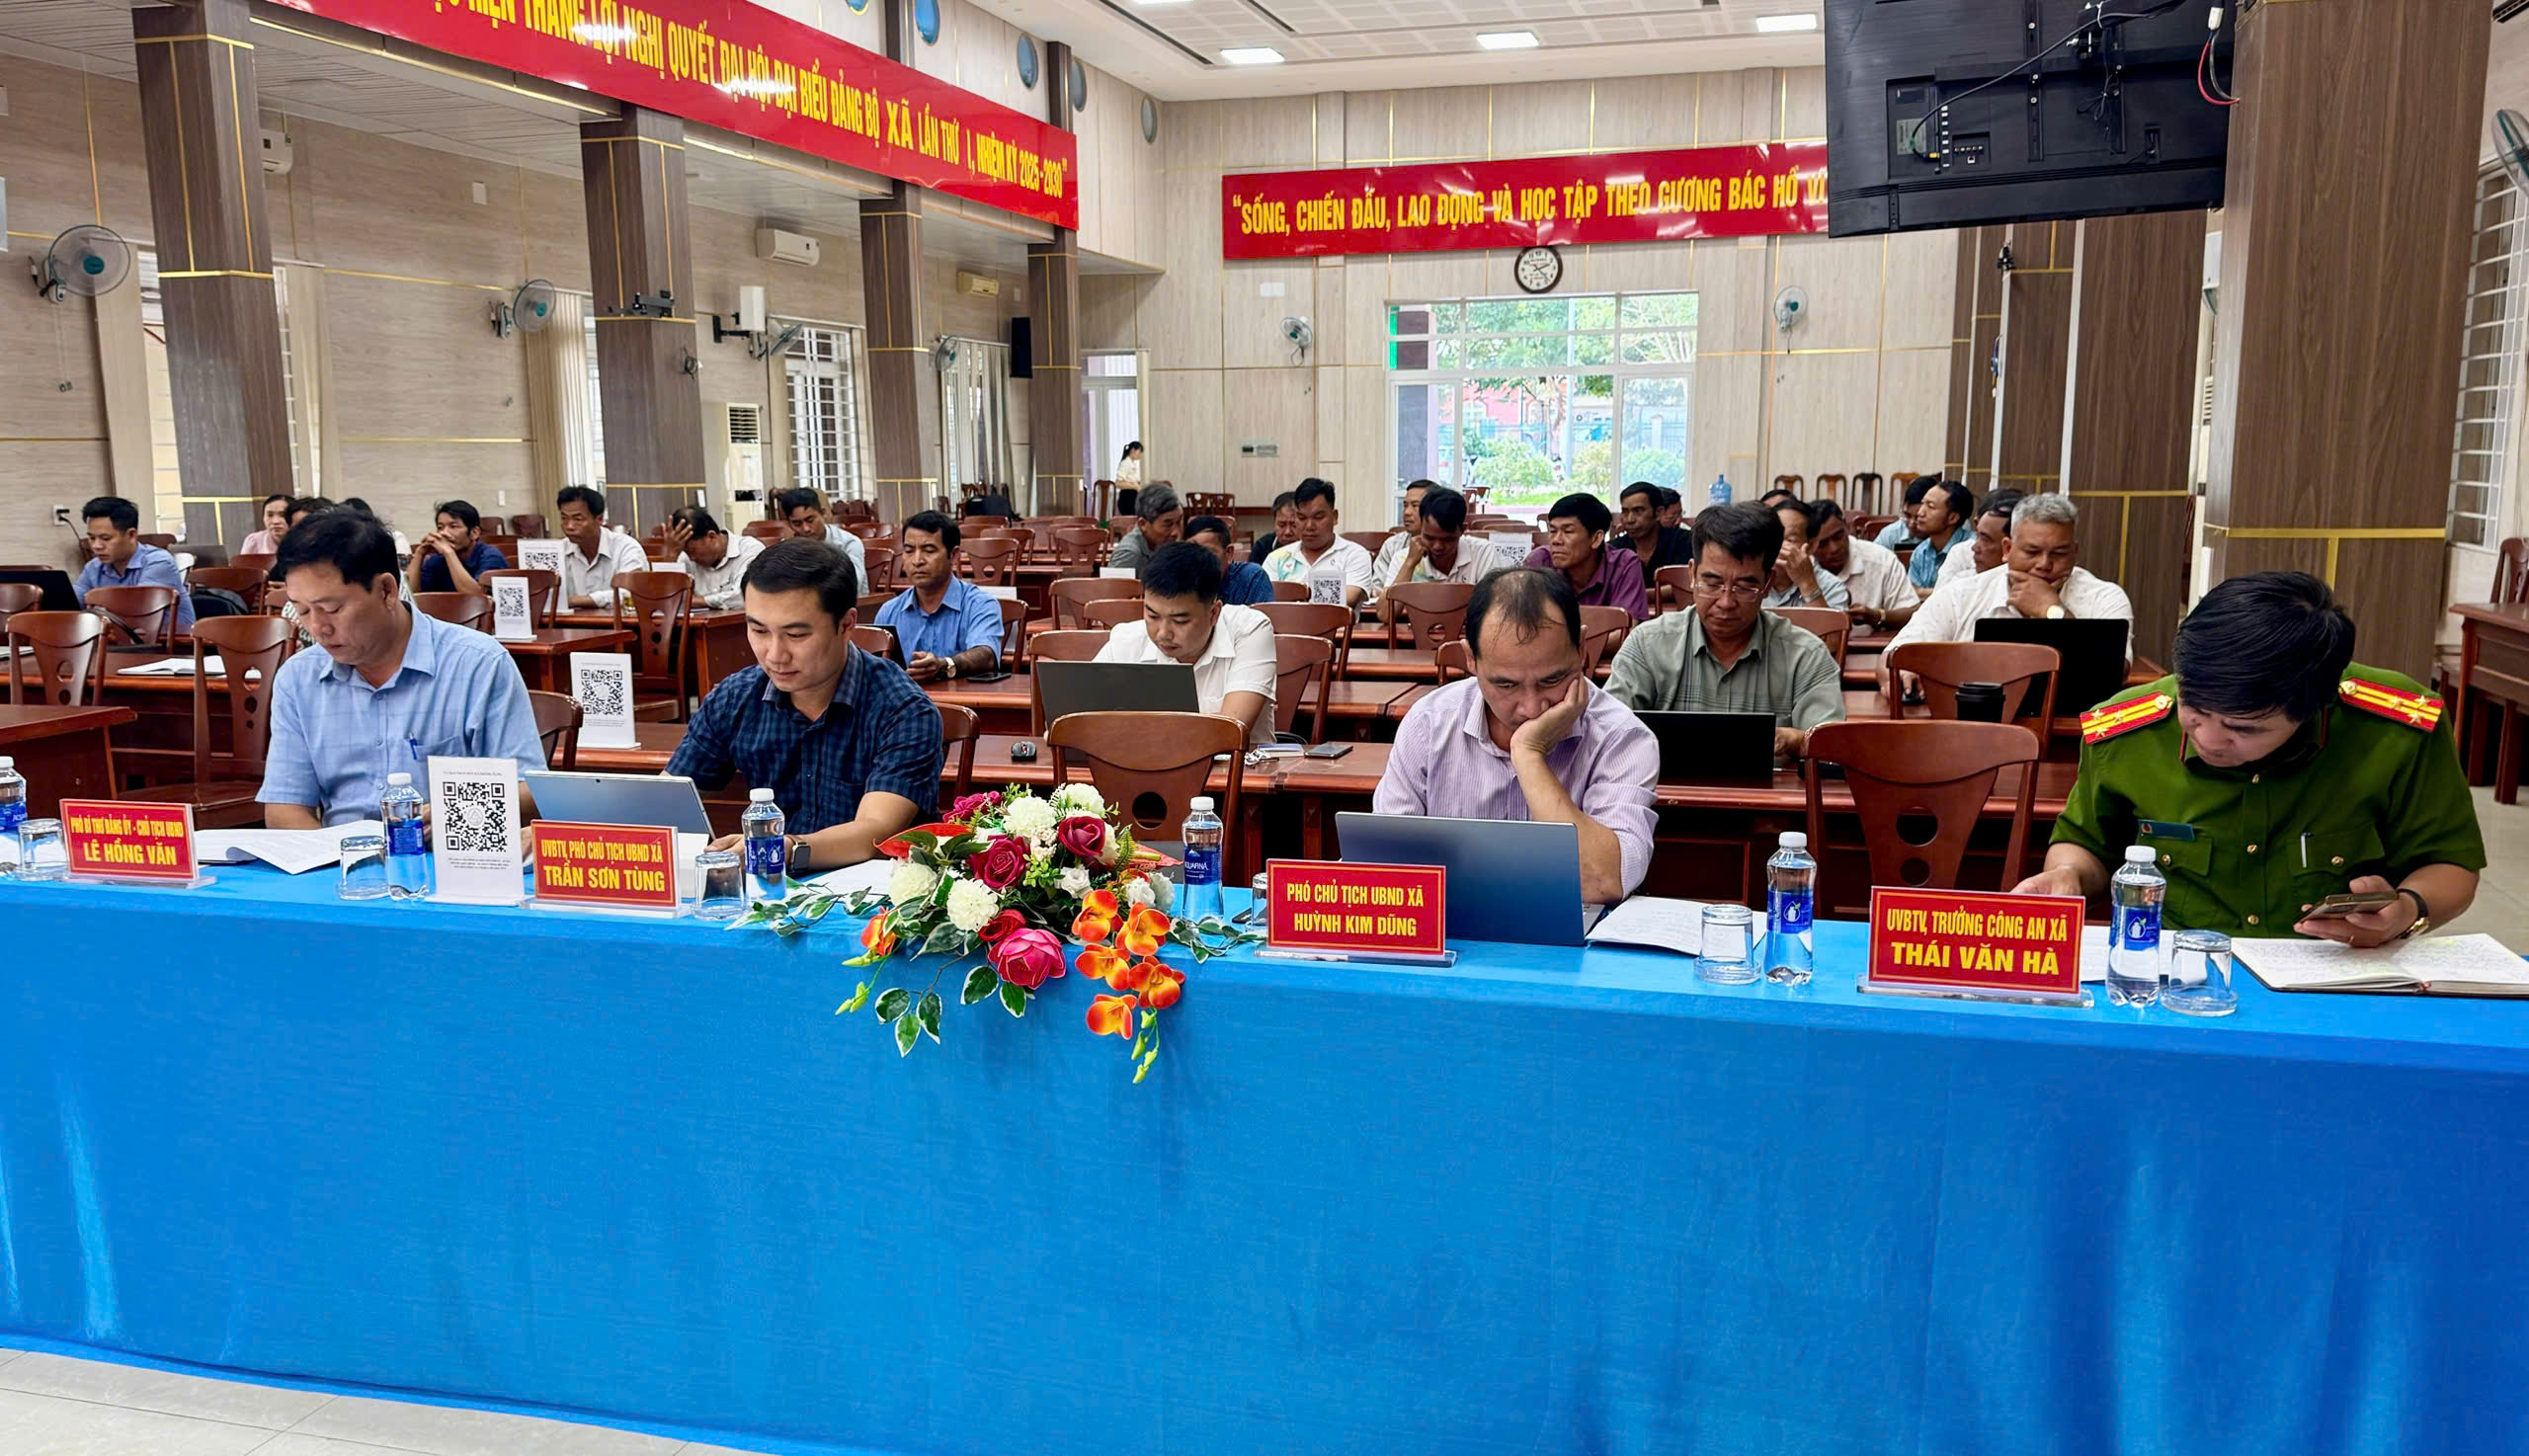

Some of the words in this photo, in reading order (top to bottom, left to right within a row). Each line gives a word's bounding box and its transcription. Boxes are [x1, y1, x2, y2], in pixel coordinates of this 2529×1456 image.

[623, 5, 665, 80] NGHỊ
[668, 20, 716, 87] QUYẾT
[799, 57, 829, 123] BIỂU
[830, 68, 863, 135] ĐẢNG
[864, 87, 881, 148] BỘ
[885, 98, 915, 151] XÃ
[940, 117, 961, 166] THỨ
[976, 130, 1007, 183] NHIỆM
[1005, 138, 1018, 184] KỲ
[1296, 191, 1346, 232] CHIẾN
[1397, 195, 1430, 228] LAO
[1437, 187, 1485, 230] ĐỘNG
[1492, 184, 1513, 222] VÀ
[1520, 186, 1557, 227] HỌC
[1563, 179, 1598, 225] TẬP
[1605, 182, 1651, 217] THEO
[1658, 177, 1722, 213] GƯƠNG
[1729, 170, 1766, 210] BÁC
[1772, 165, 1800, 209] HỒ
[70, 814, 84, 834] PHÓ
[83, 839, 102, 862] LÊ
[146, 841, 178, 865] VĂN
[569, 837, 586, 858] PHÓ
[588, 836, 605, 860] CHỦ
[606, 842, 624, 864] TỊCH
[626, 843, 649, 862] UBND
[651, 841, 664, 863] XÃ
[542, 858, 585, 888] TRẦN
[588, 865, 620, 890] SƠN
[623, 864, 665, 892] TÙNG
[1286, 879, 1311, 902] PHÓ
[1314, 878, 1338, 904] CHỦ
[1341, 885, 1368, 908] TỊCH
[1370, 886, 1404, 906] UBND
[1407, 884, 1424, 908] XÃ
[1294, 910, 1342, 933] HUỲNH
[1346, 915, 1373, 934] KIM
[1377, 913, 1417, 936] DŨNG
[1887, 908, 1928, 935] UVBTV,
[1931, 905, 1984, 937] TRƯỞNG
[1987, 910, 2024, 939] CÔNG
[2026, 917, 2046, 940] AN
[2049, 914, 2068, 942] XÃ
[1891, 939, 1950, 968] THÁI
[1959, 942, 2014, 972] VĂN
[2022, 947, 2060, 976] HÀ
